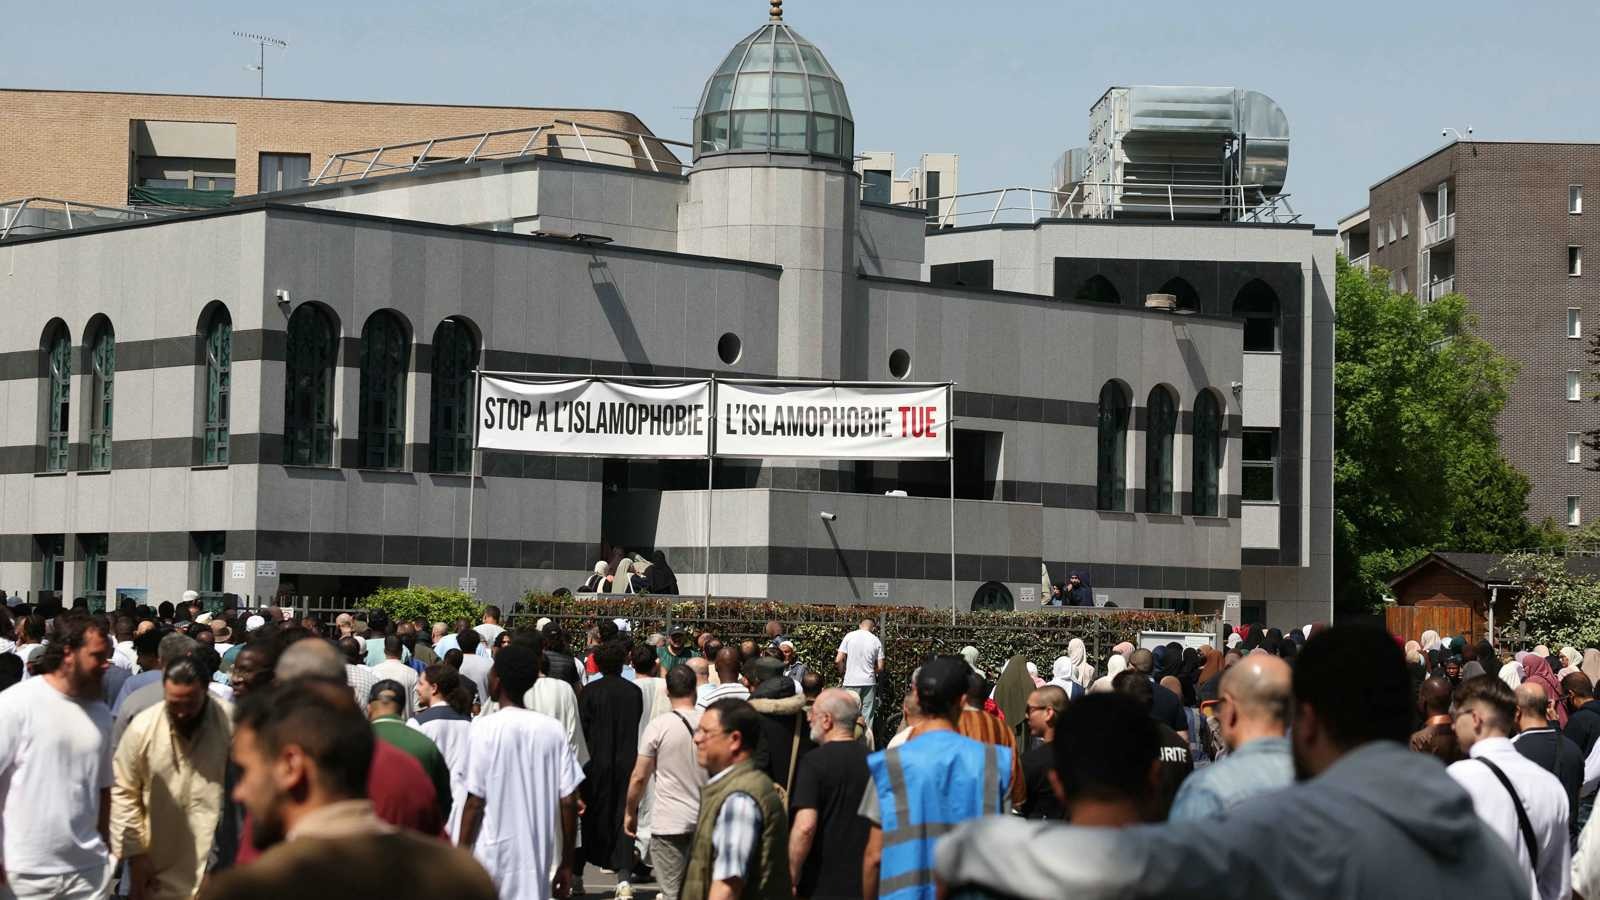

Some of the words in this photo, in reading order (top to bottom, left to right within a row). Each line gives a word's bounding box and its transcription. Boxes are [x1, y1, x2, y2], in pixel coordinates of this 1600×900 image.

[484, 397, 531, 431] STOP
[535, 400, 548, 432] A
[554, 400, 704, 436] L'ISLAMOPHOBIE
[726, 403, 893, 438] L'ISLAMOPHOBIE
[898, 406, 937, 438] TUE
